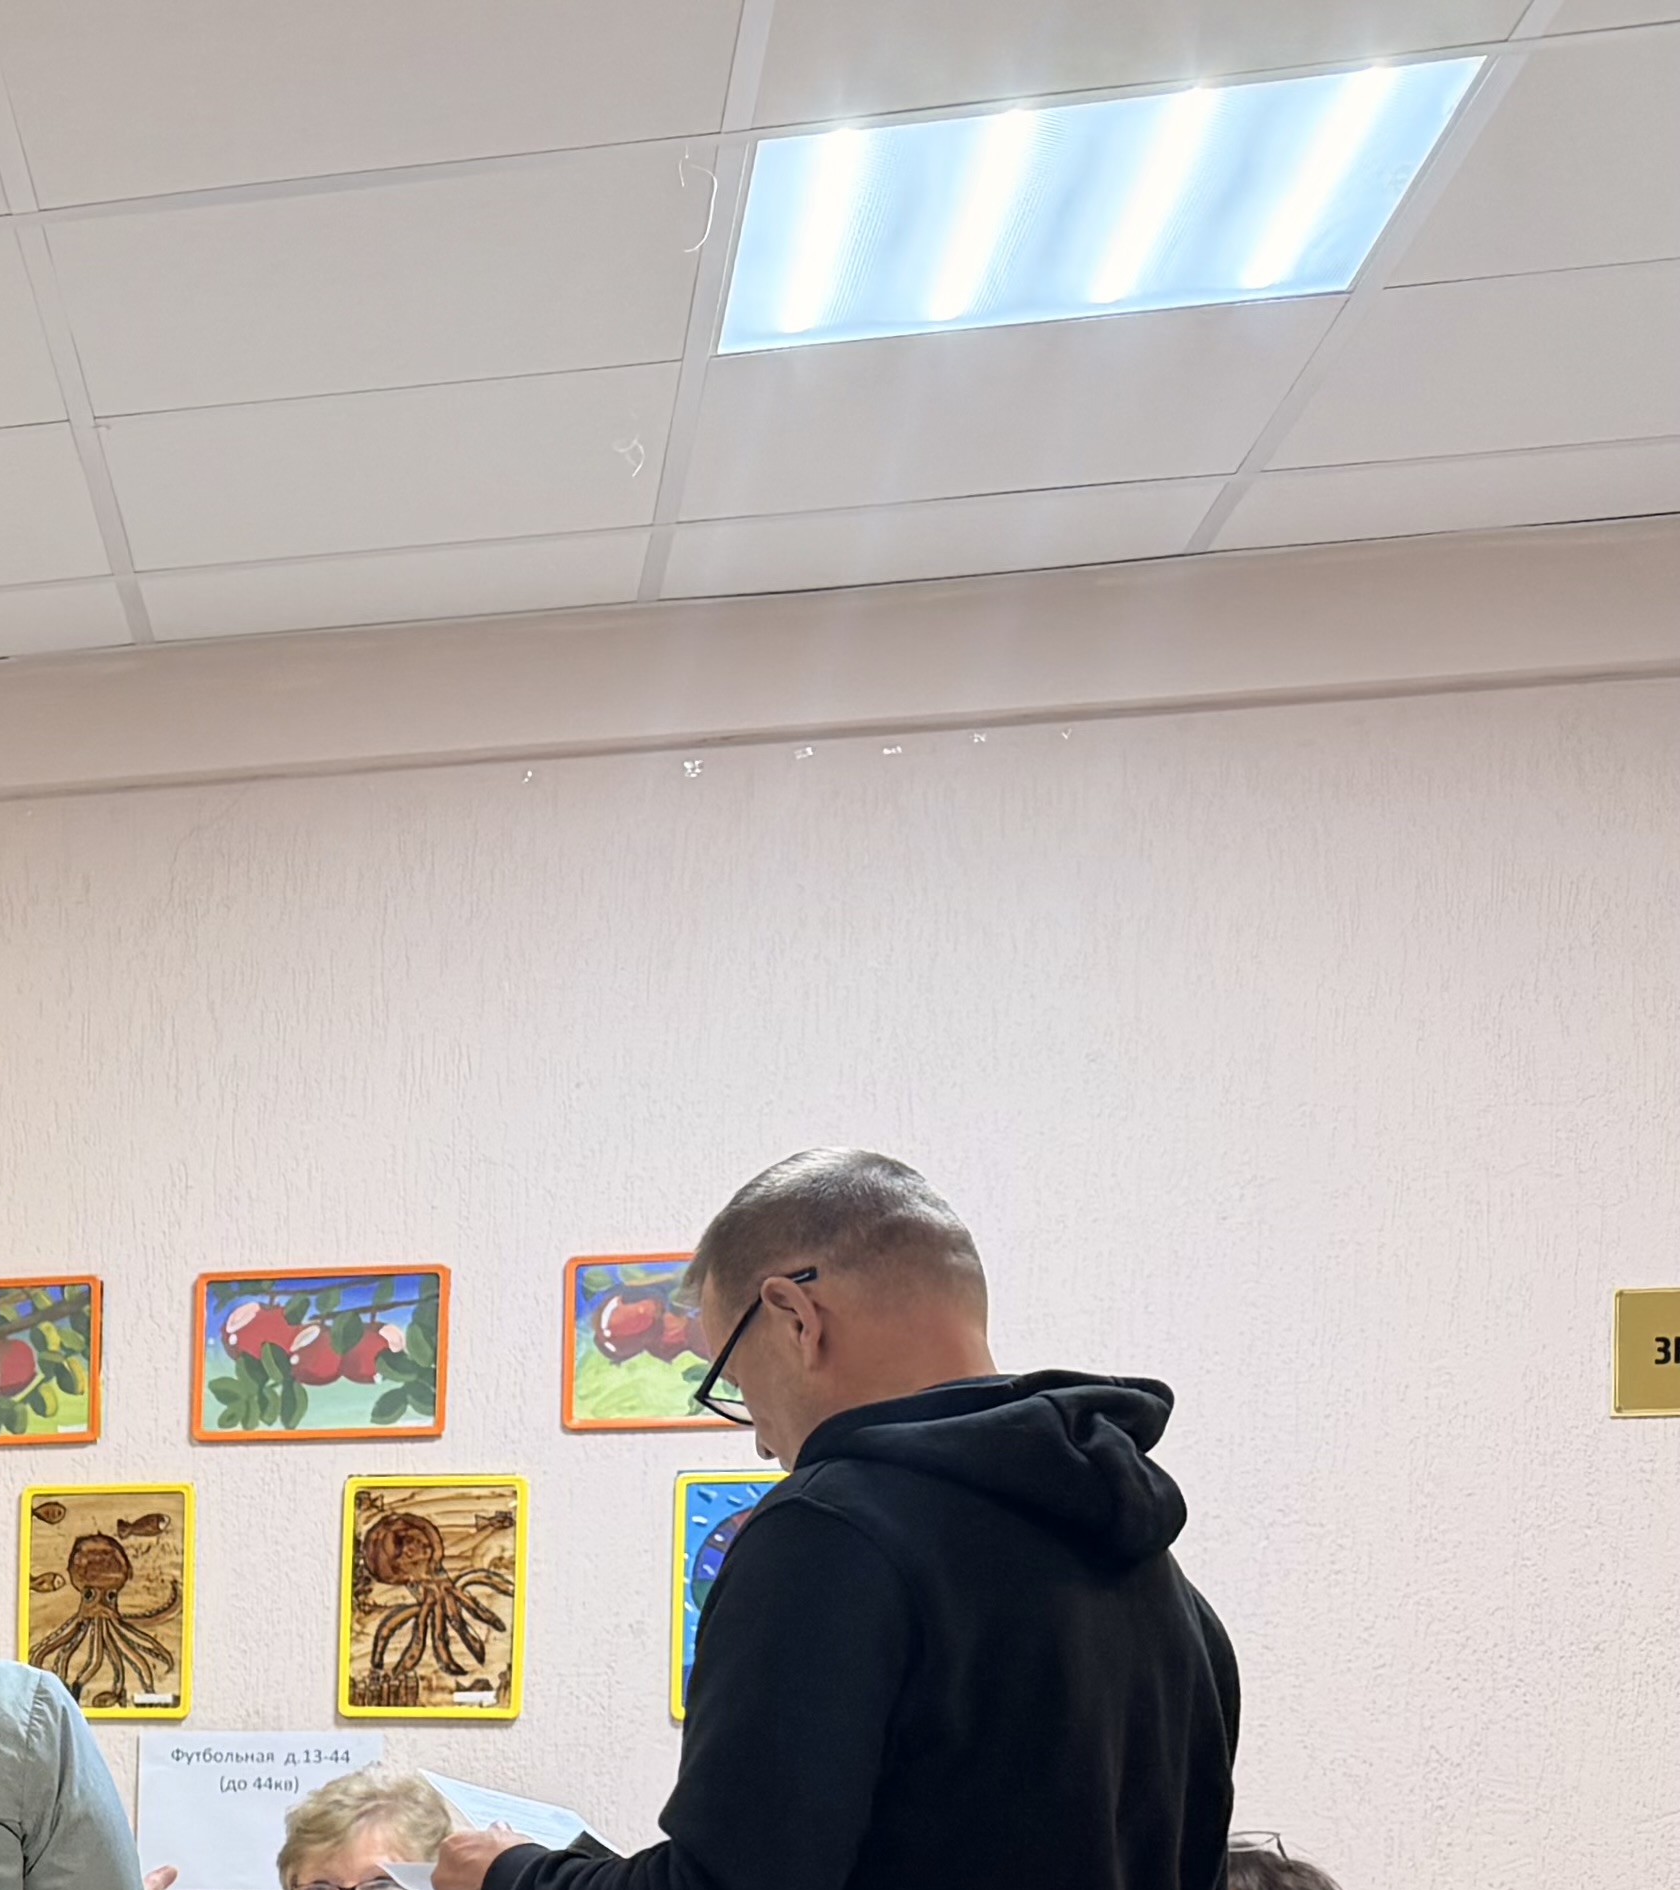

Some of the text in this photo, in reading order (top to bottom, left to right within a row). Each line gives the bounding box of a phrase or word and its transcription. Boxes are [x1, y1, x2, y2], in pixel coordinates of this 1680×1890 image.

[171, 1748, 350, 1766] Футбольная д.13-44
[220, 1776, 299, 1794] (до 44кв)
